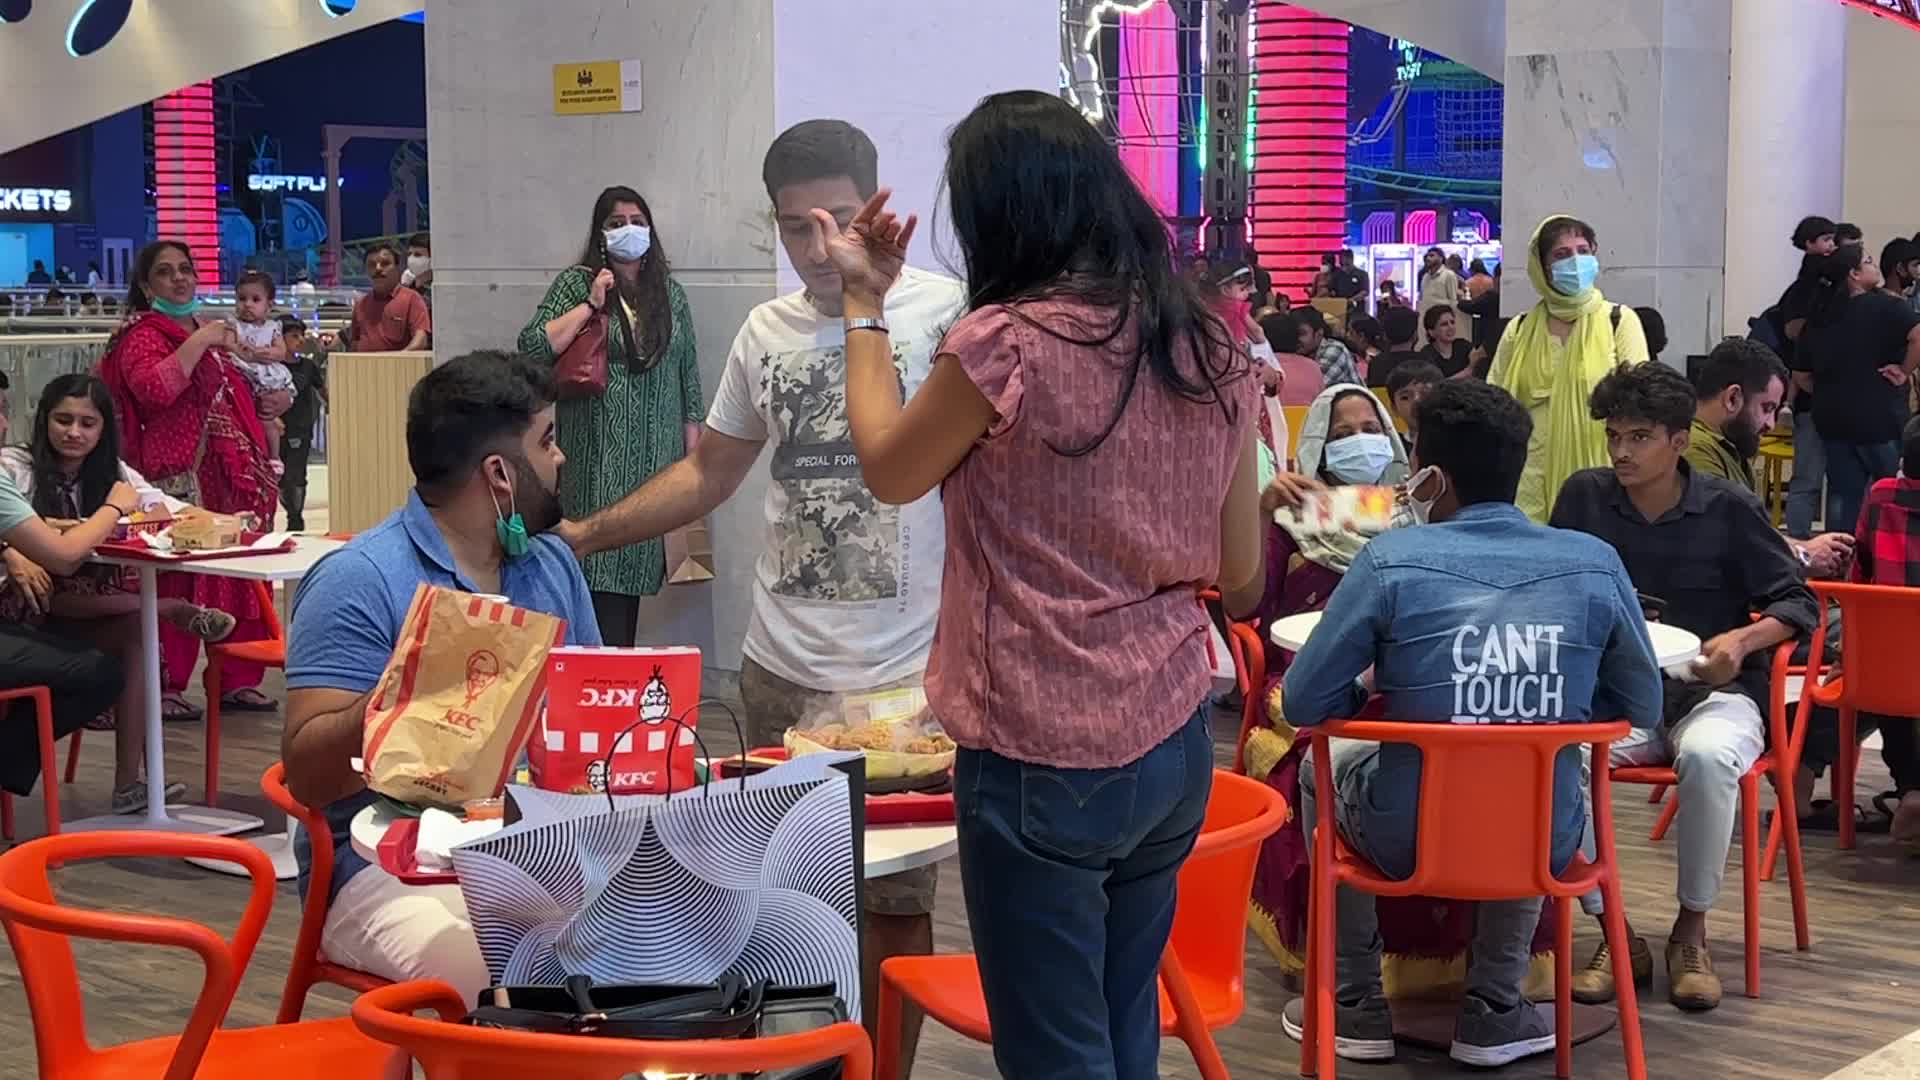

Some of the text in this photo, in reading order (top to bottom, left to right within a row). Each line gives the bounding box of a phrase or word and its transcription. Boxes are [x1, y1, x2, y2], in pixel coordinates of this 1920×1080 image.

[248, 174, 296, 191] SOFT
[0, 188, 71, 211] KETS
[794, 454, 860, 468] SPECIAL FOR
[1452, 623, 1564, 673] CAN'T
[577, 687, 638, 707] KFC
[1451, 673, 1564, 718] TOUCH
[444, 708, 481, 731] KFC
[613, 771, 657, 786] KFC
